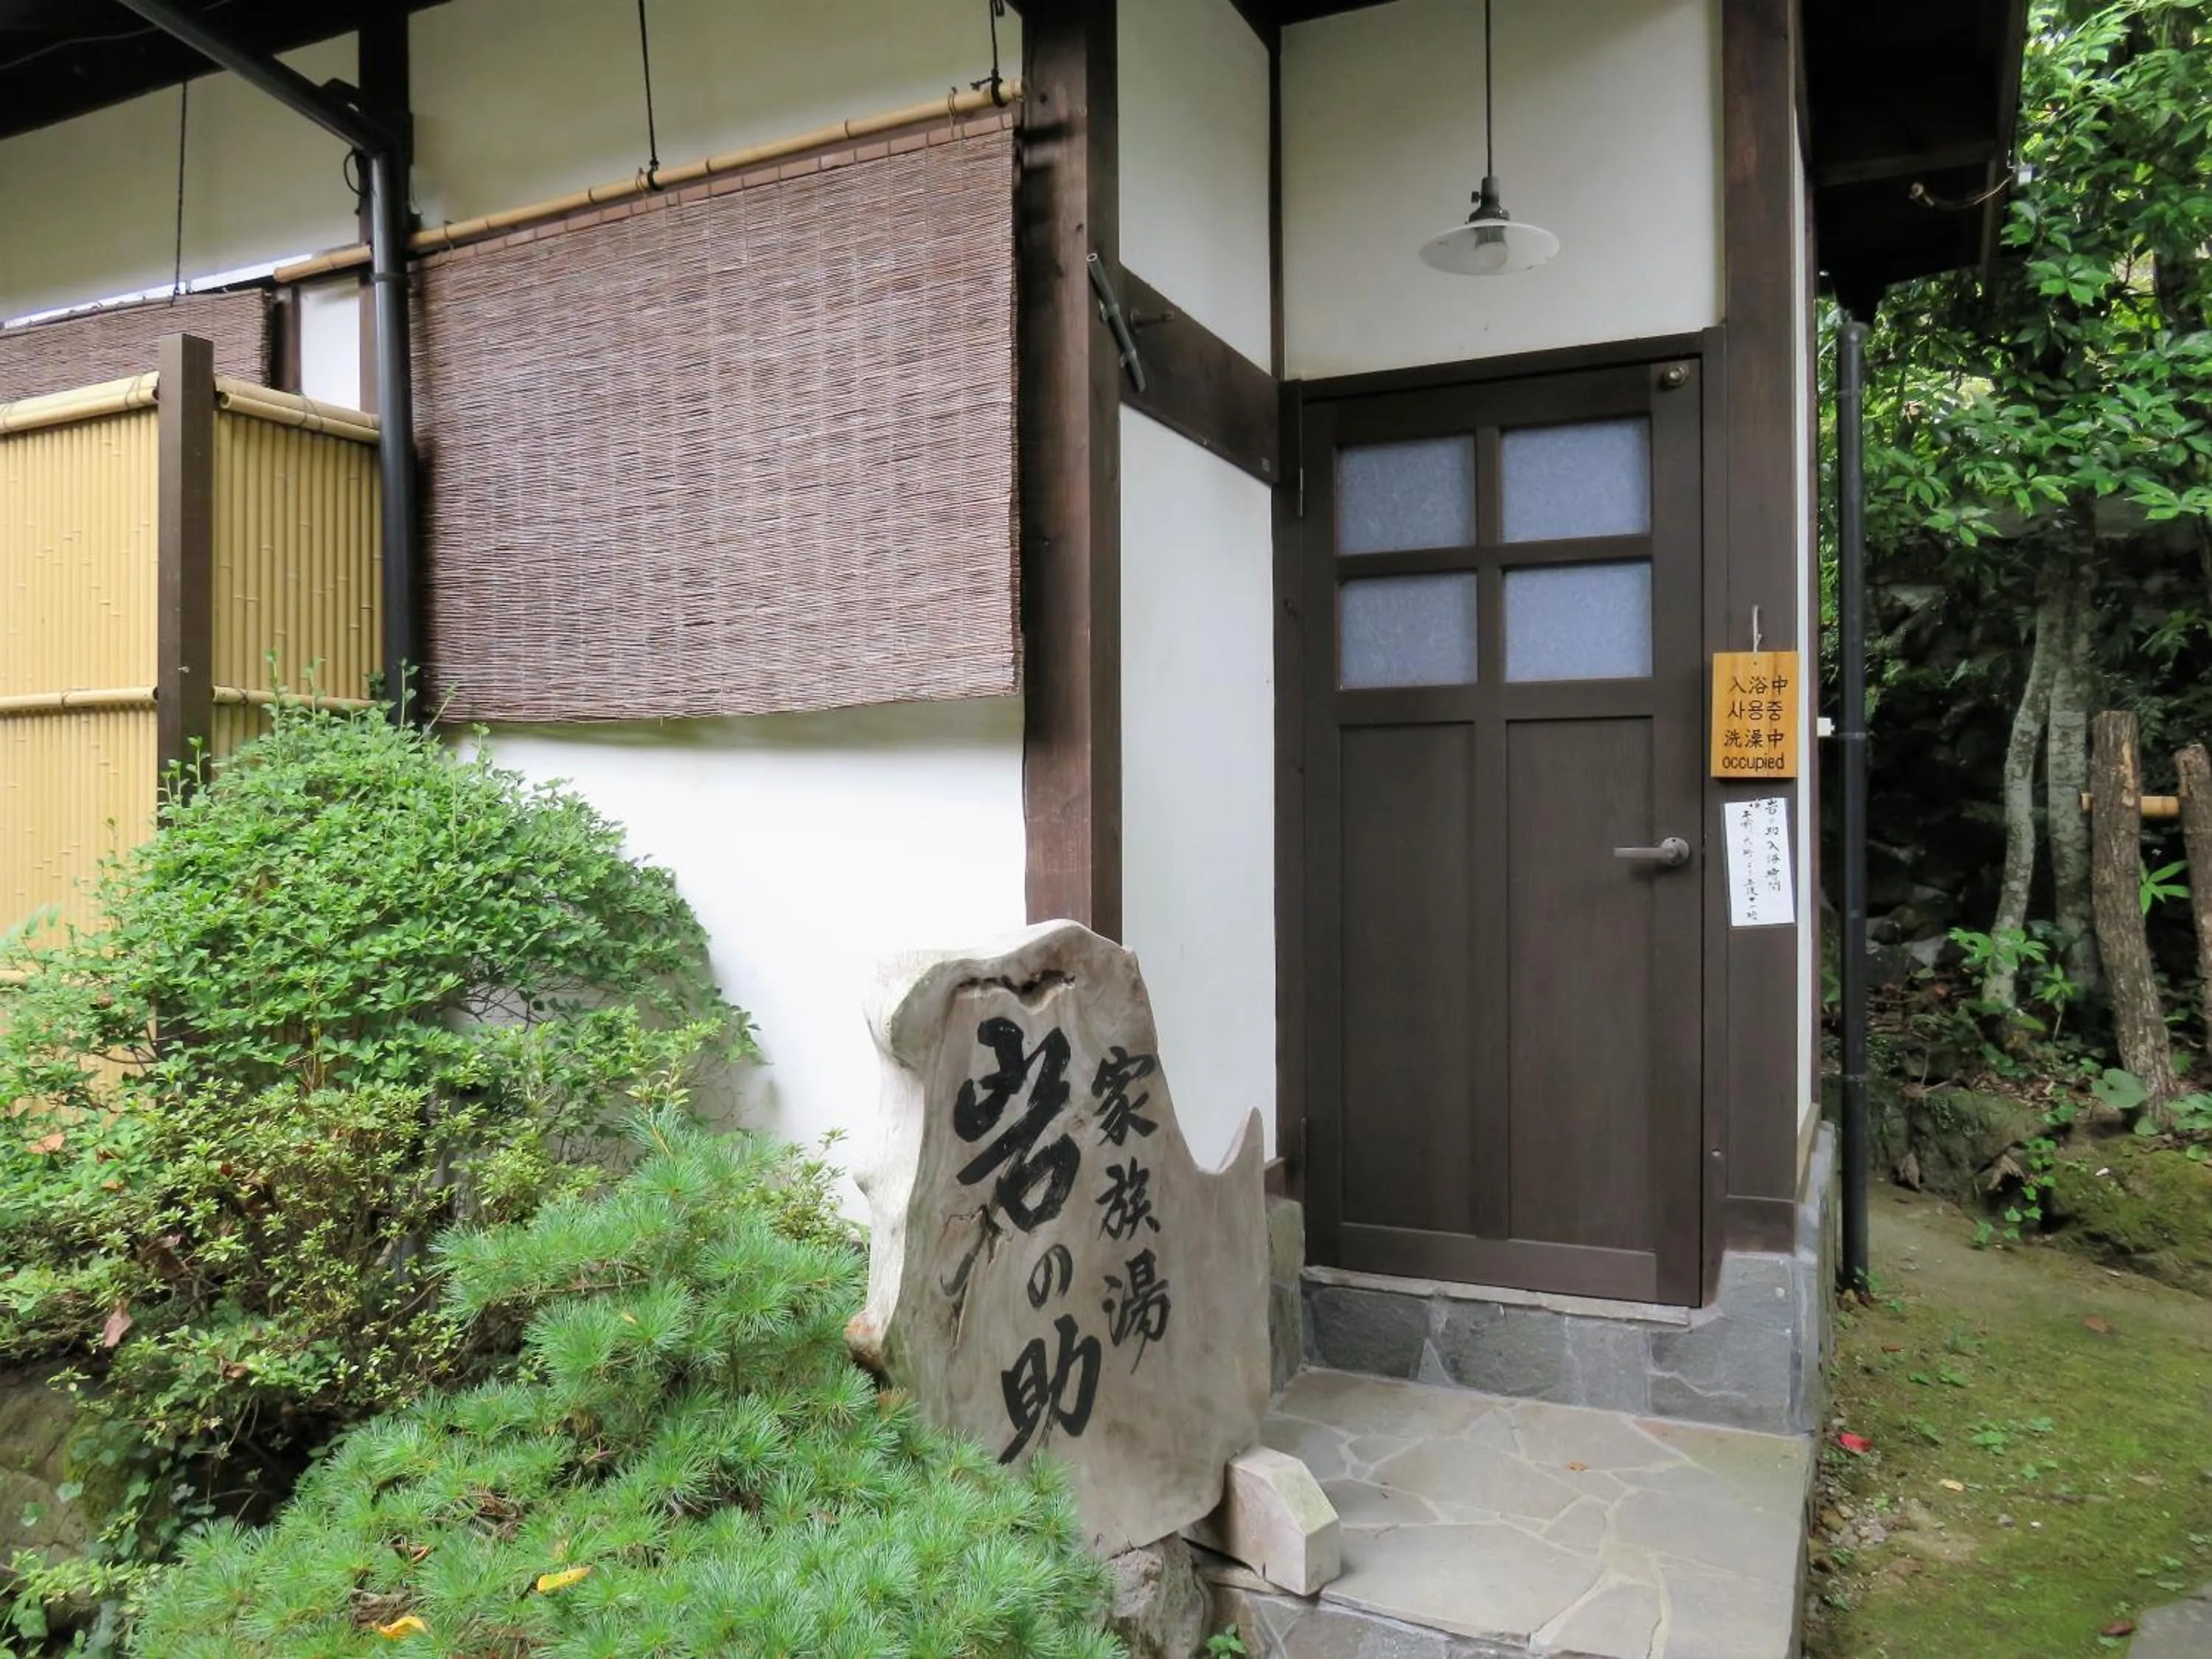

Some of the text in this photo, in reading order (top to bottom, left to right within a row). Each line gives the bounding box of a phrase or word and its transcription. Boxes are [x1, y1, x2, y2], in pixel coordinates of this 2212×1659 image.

[1728, 674, 1788, 695] 入浴中
[1727, 700, 1784, 721] 사용중
[1723, 728, 1784, 750] 洗澡中
[1722, 753, 1785, 772] occupied
[1091, 1046, 1172, 1374] 家族湯
[950, 1016, 1102, 1466] 岩の助
